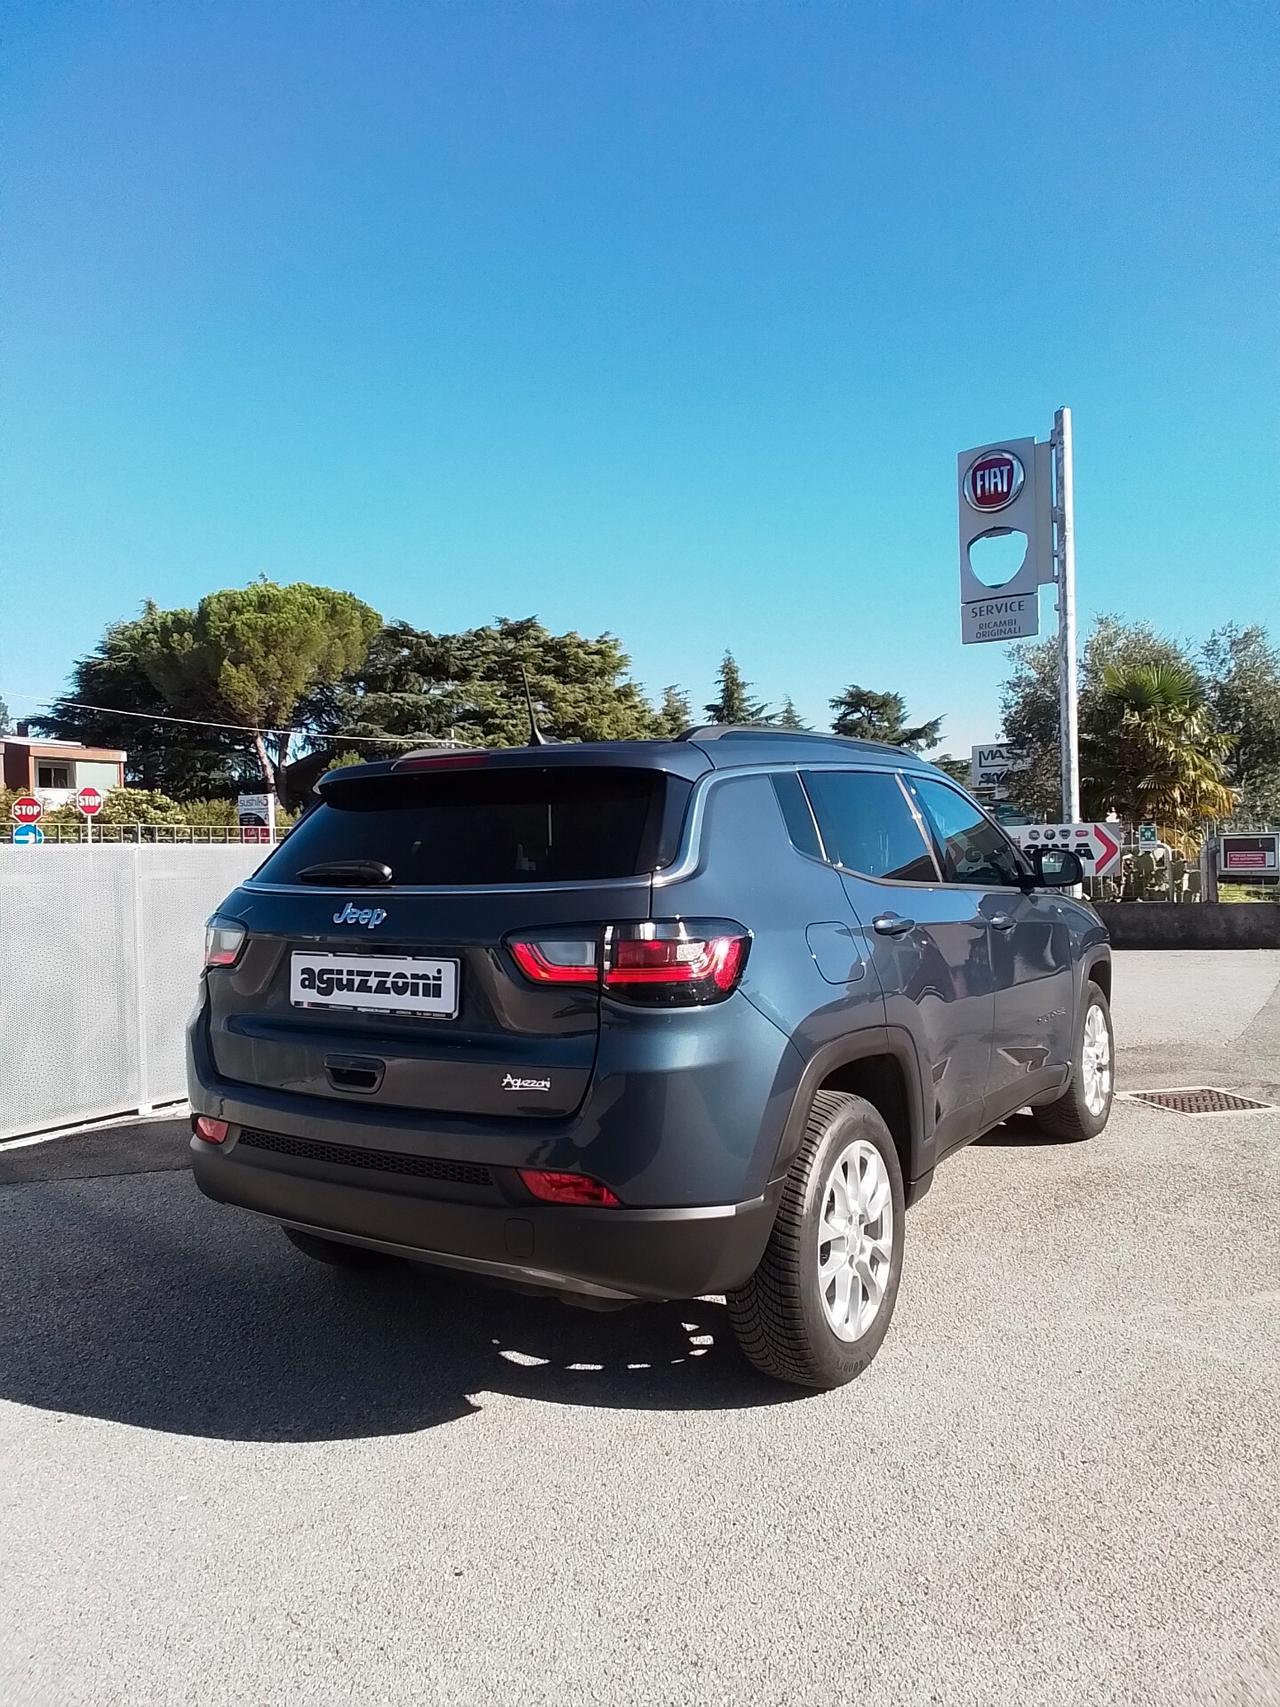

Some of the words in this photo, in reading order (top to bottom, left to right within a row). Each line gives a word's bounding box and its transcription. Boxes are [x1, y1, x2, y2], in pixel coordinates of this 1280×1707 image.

[976, 465, 1011, 498] FIAT
[971, 600, 1025, 618] SERVICE
[978, 618, 1017, 631] RICAMBI
[975, 627, 1021, 640] ORIGINALI
[78, 795, 101, 807] STOP
[14, 805, 40, 816] STOP
[333, 902, 388, 928] Jeep
[299, 966, 442, 998] aguzzoni
